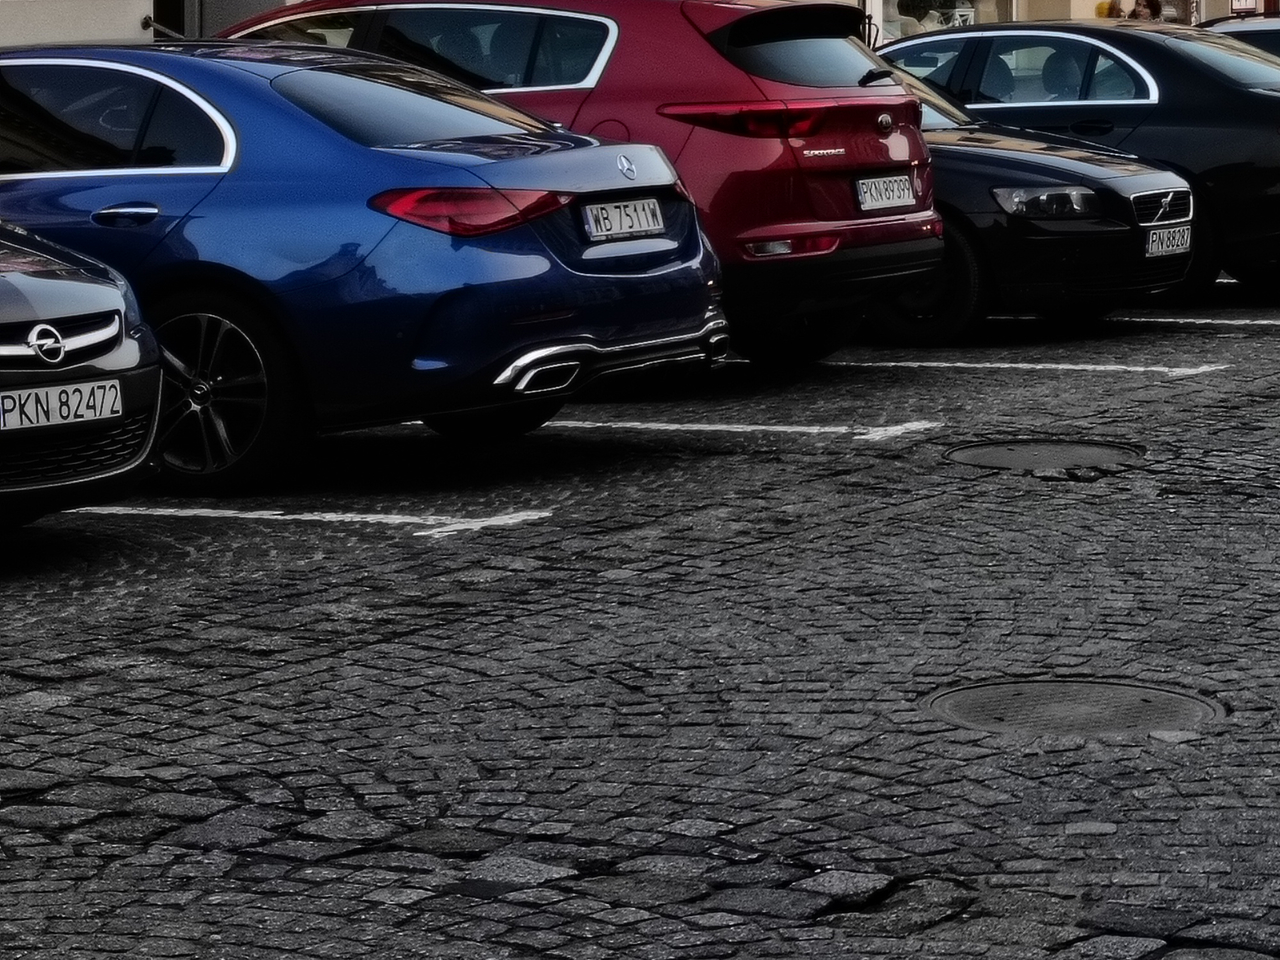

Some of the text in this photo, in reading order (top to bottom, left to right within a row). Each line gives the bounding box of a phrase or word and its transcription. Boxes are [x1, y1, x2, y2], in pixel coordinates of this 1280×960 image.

[861, 178, 911, 203] PKN 89399
[590, 202, 660, 233] WB 7511W
[1151, 231, 1164, 252] PN
[1, 383, 120, 428] PKN 82472
